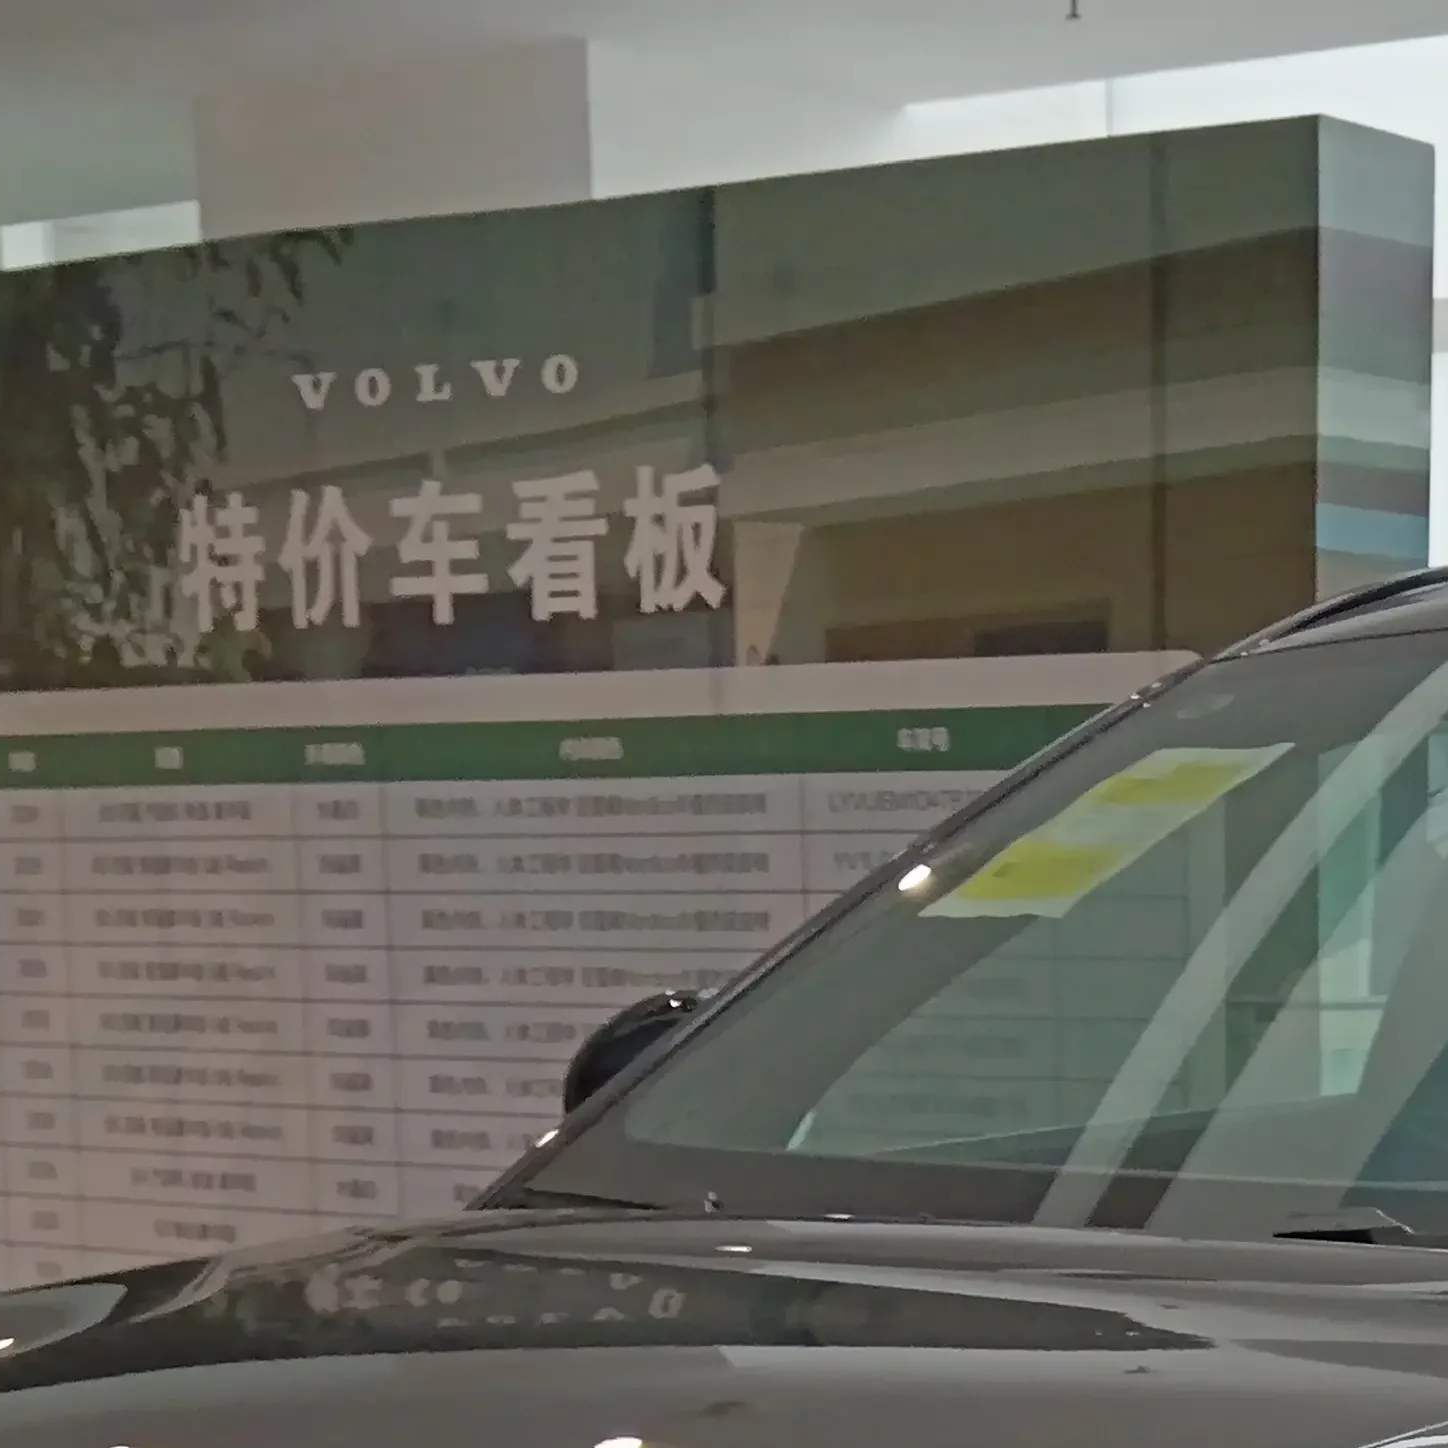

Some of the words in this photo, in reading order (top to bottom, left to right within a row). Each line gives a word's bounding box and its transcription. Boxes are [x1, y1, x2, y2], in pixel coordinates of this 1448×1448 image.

[291, 353, 579, 410] VOLVO
[178, 464, 727, 632] 特价车看板
